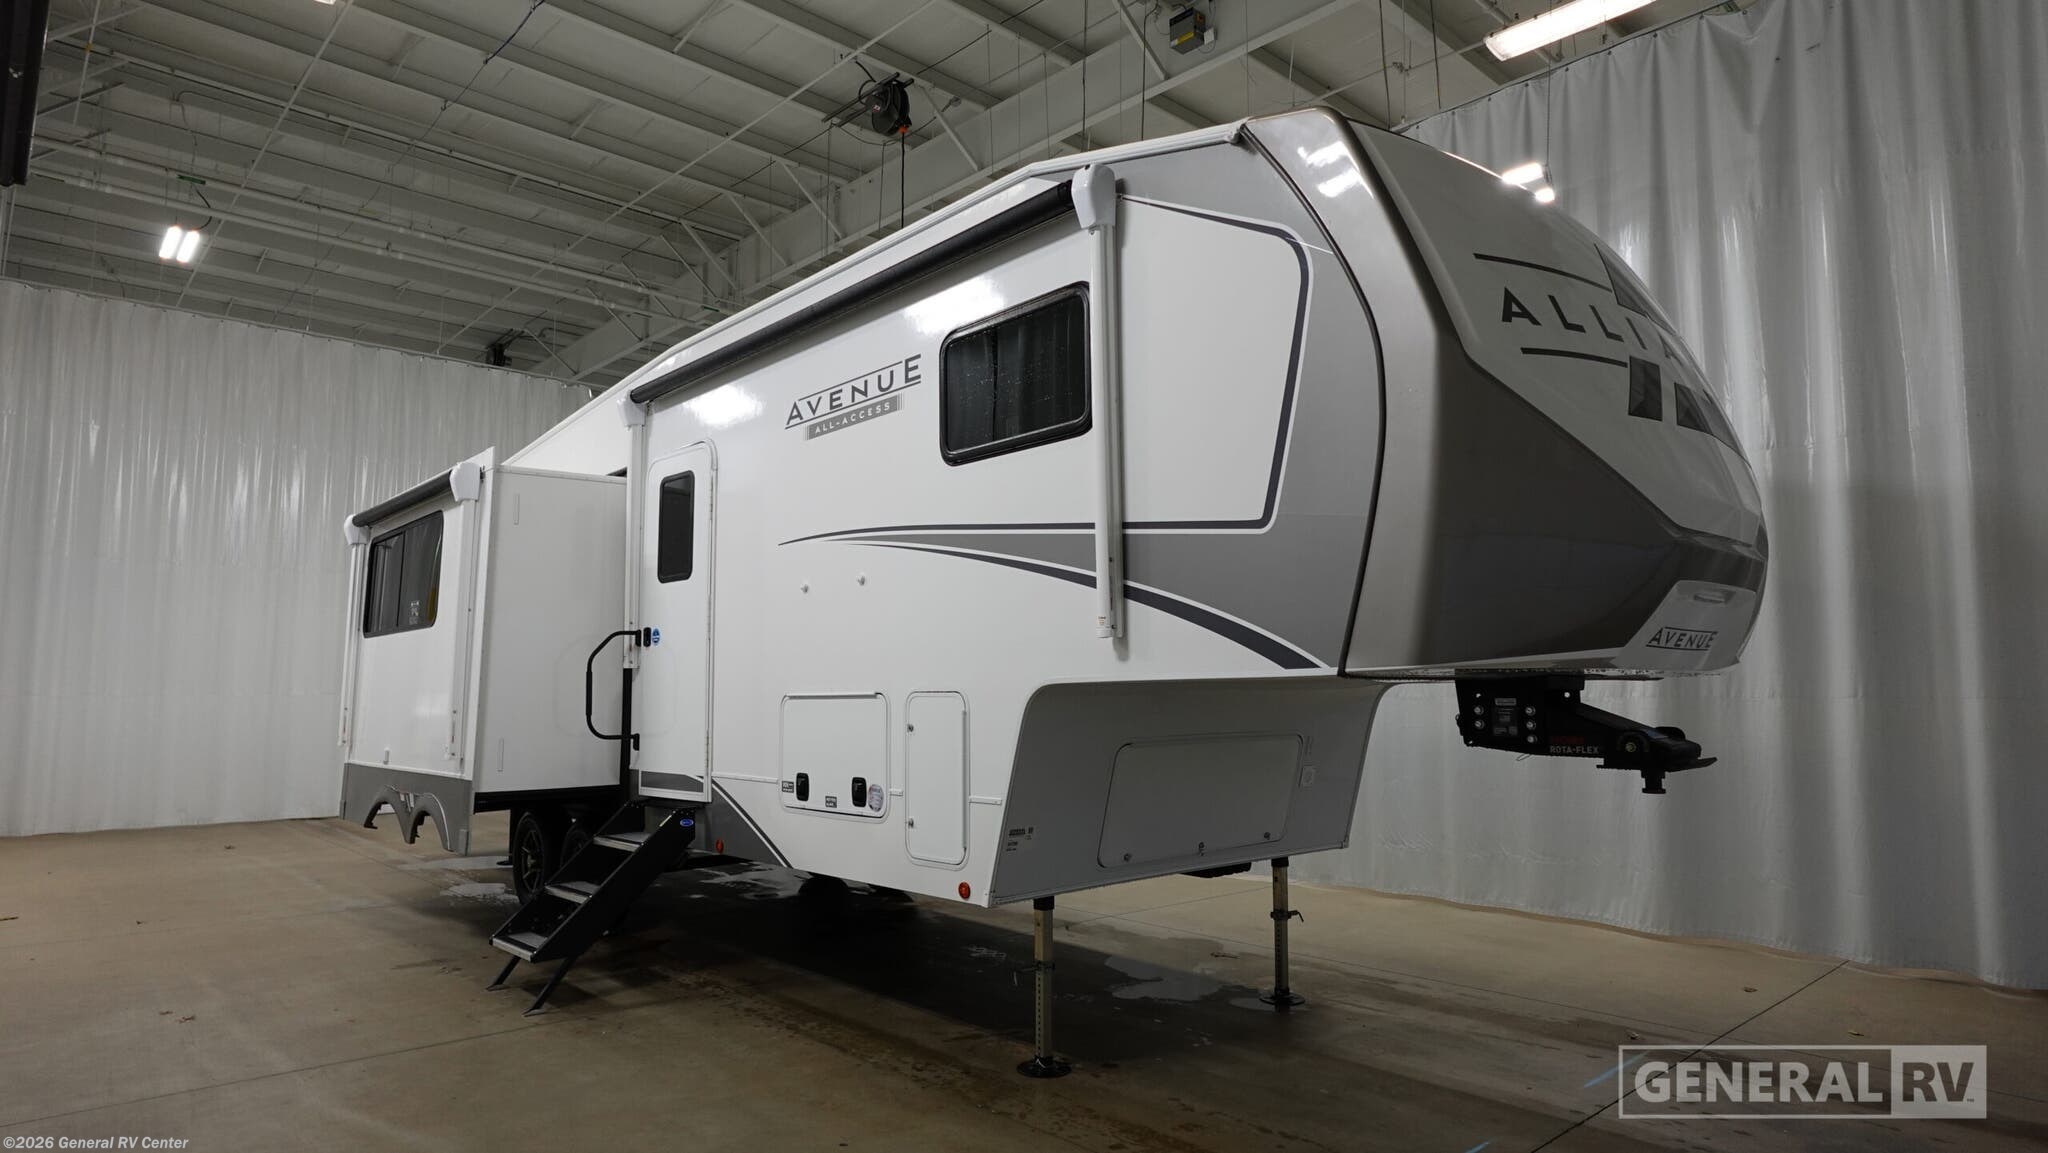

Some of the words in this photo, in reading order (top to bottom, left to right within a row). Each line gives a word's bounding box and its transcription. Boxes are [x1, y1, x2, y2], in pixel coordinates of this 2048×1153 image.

[786, 353, 922, 426] AVENUE
[814, 401, 891, 434] ALL-ACCESS
[1647, 627, 1718, 649] AVENUE
